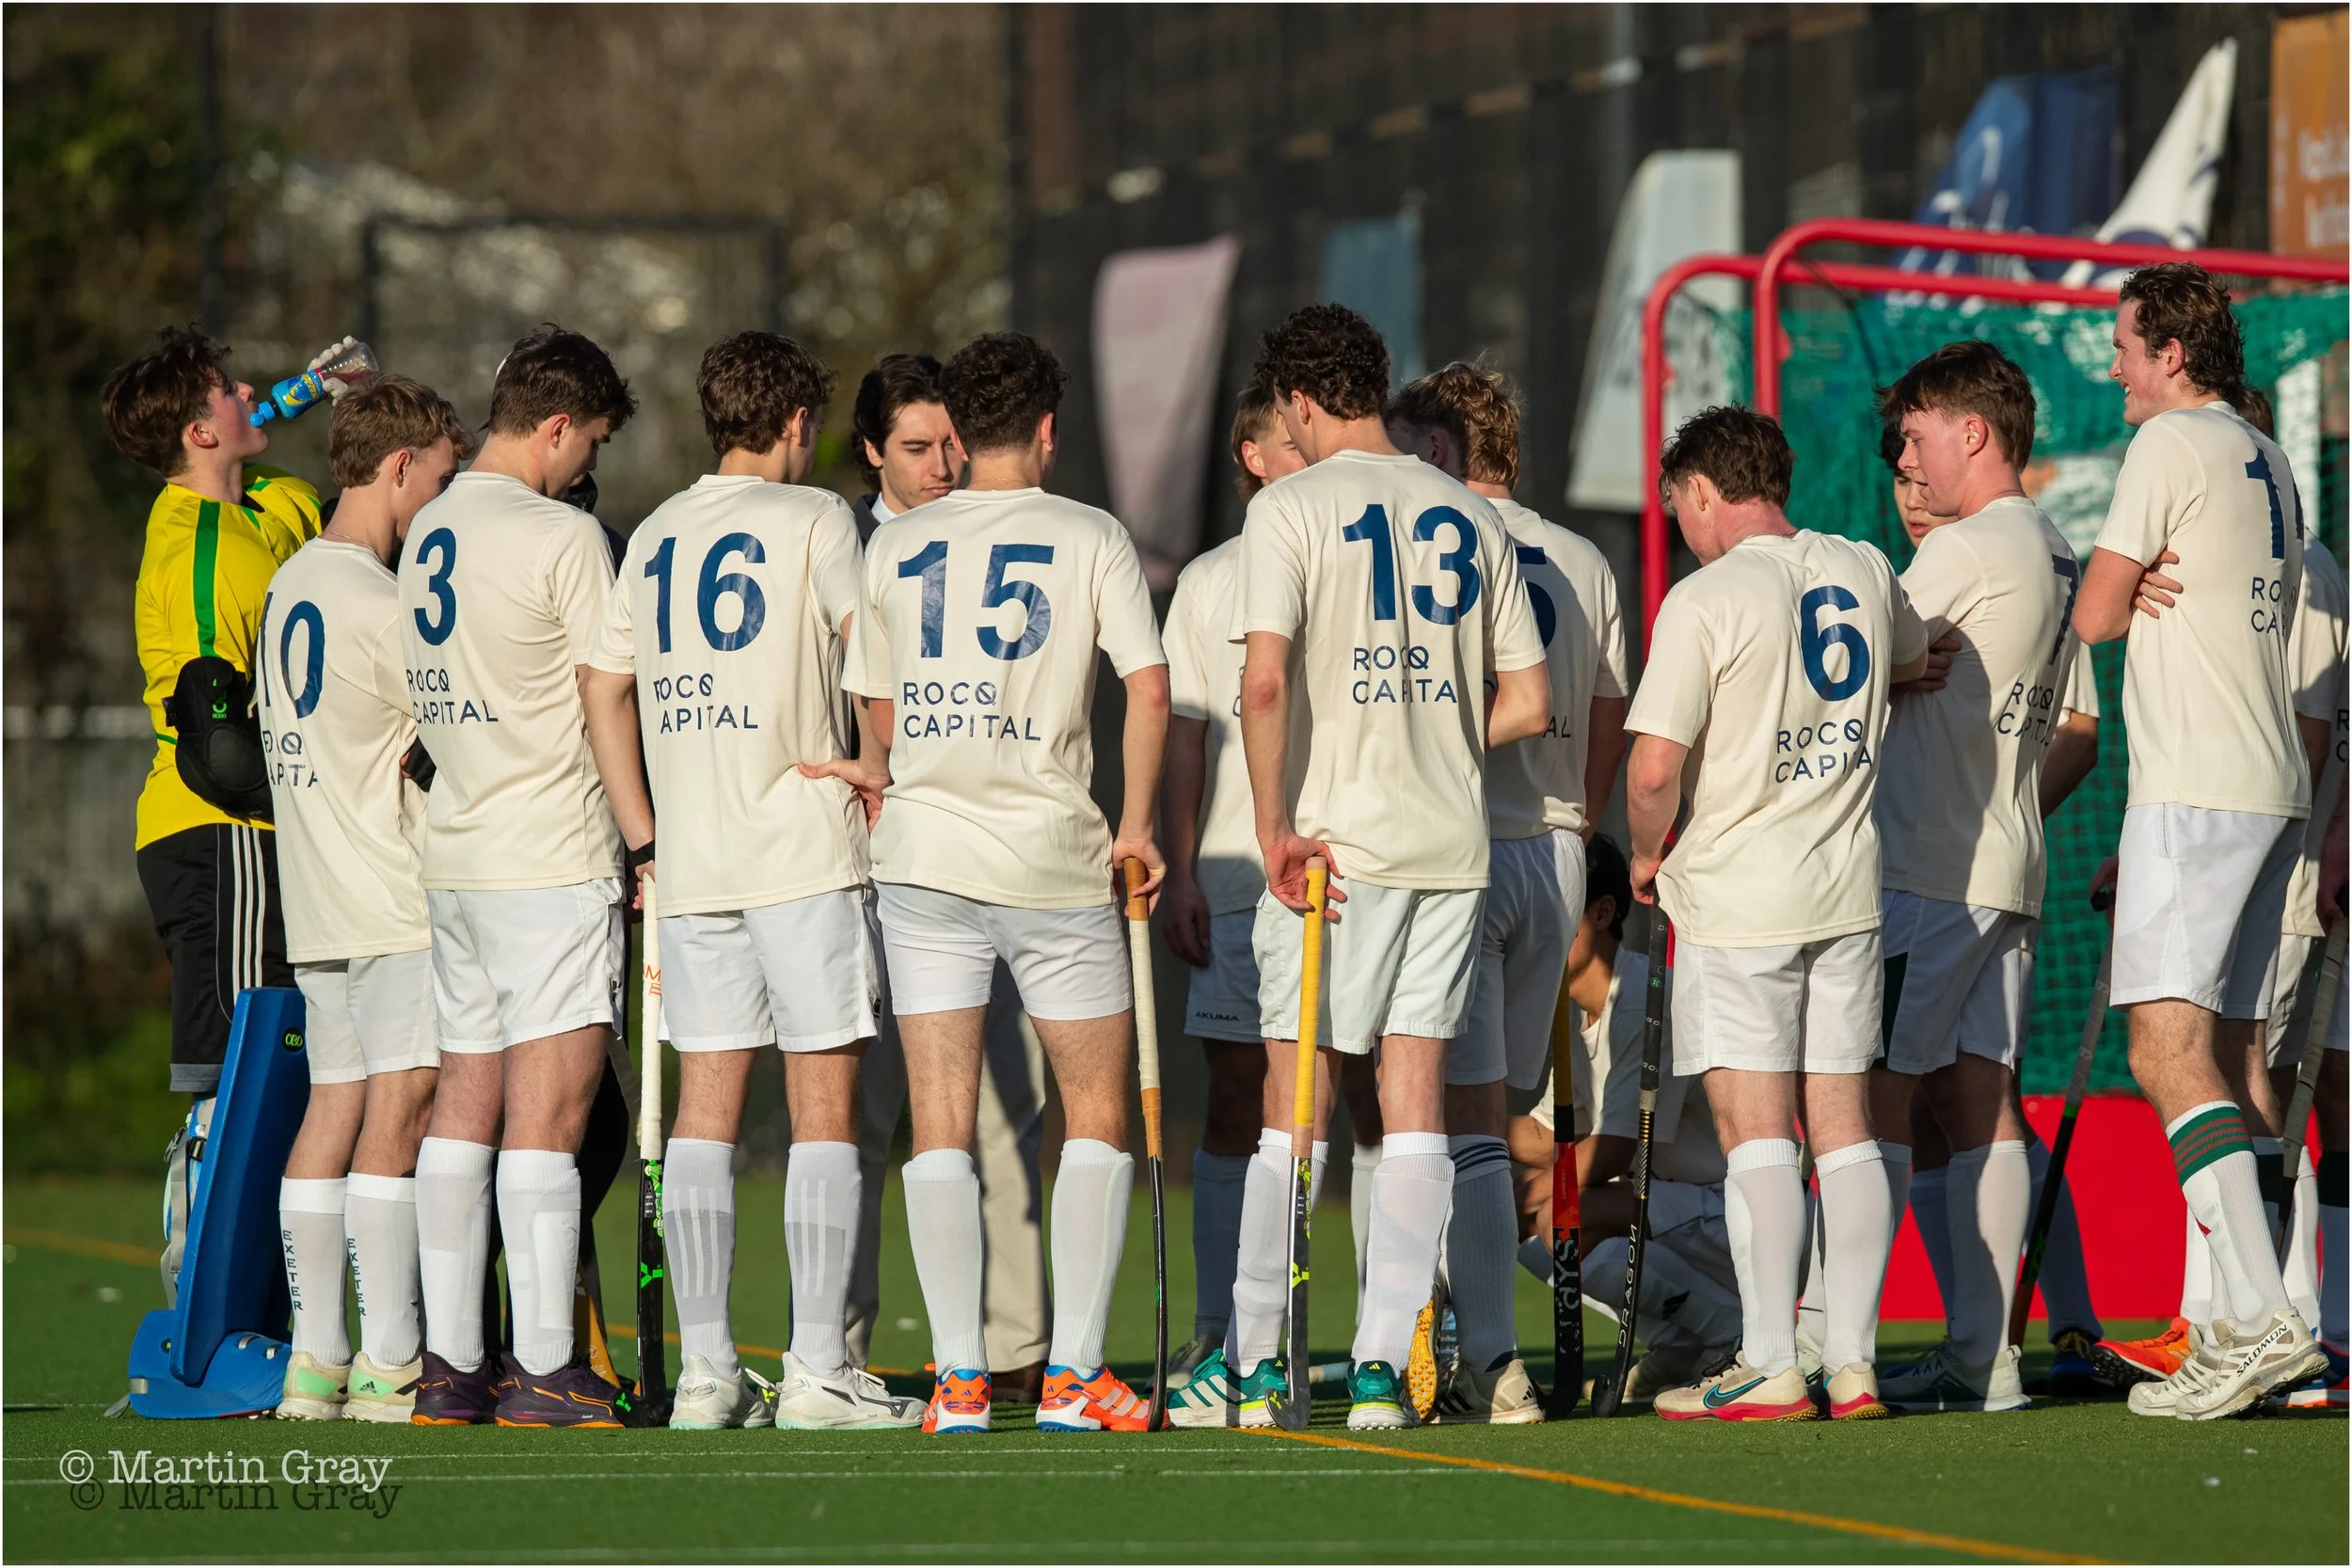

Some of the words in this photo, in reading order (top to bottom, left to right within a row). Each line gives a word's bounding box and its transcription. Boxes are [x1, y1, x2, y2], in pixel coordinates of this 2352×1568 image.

[414, 527, 457, 646] 3
[644, 531, 766, 654] 16
[898, 541, 1055, 661] 15
[1342, 503, 1481, 626] 13
[260, 591, 326, 720] 10
[406, 668, 451, 692] ROCQ
[1800, 584, 1871, 702] 6
[413, 700, 499, 725] CAPITAL
[903, 681, 997, 706] ROCQ
[903, 713, 1041, 741] CAPITAL
[1776, 718, 1865, 754] ROCQ
[1195, 1011, 1240, 1022] AKUMA
[282, 1229, 304, 1311] EXETER
[346, 1238, 367, 1317] EXETER
[1618, 1224, 1638, 1348] DRAGON
[2236, 1323, 2288, 1378] SALOMON
